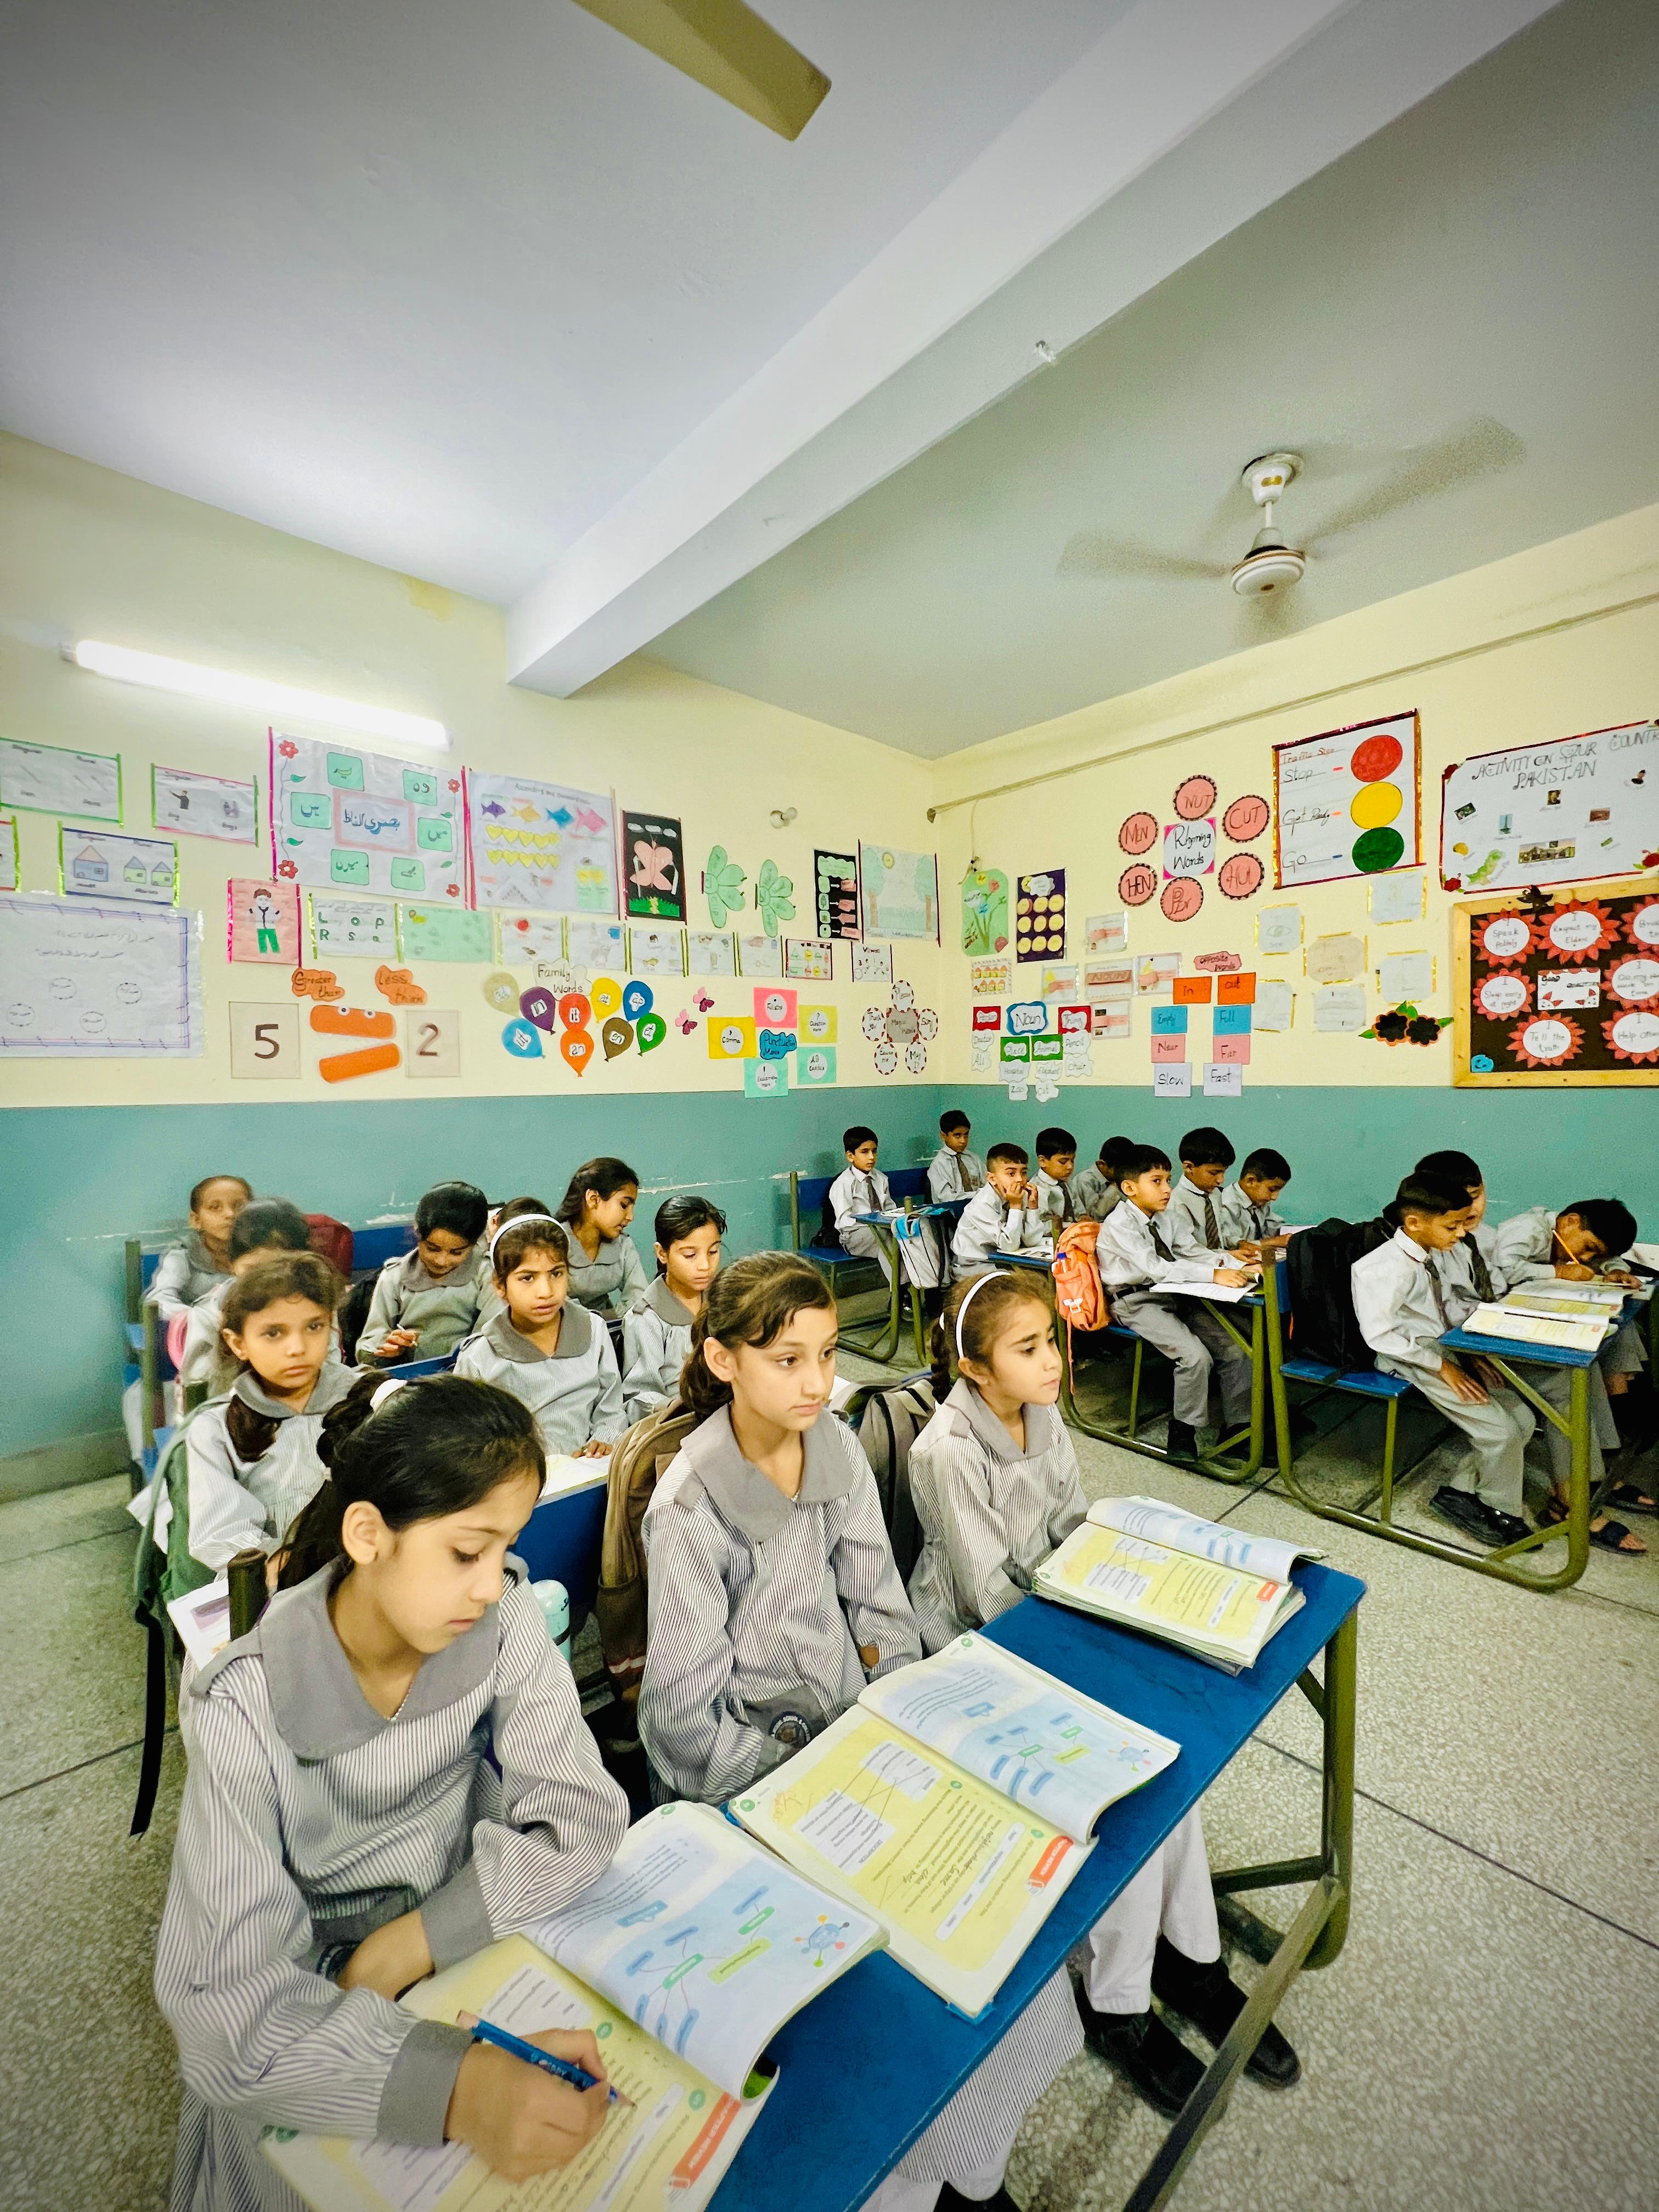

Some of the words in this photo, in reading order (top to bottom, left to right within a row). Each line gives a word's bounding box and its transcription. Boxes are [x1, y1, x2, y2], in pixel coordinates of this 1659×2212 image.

[1284, 765, 1313, 783] Stop
[1513, 759, 1597, 790] PAKISTAN
[1185, 794, 1212, 809] NUT
[1229, 804, 1262, 829] CUT
[1174, 825, 1211, 849] Rhyming
[1174, 852, 1205, 870] Words
[1282, 851, 1307, 874] Go
[538, 964, 570, 981] Family
[554, 980, 583, 994] Words
[1183, 985, 1194, 996] In
[1016, 1013, 1041, 1028] Noun
[255, 1024, 280, 1058] 5
[416, 1023, 439, 1057] 2
[1158, 1041, 1178, 1053] Near
[572, 1045, 584, 1056] an
[1221, 1045, 1237, 1059] Far
[1158, 1073, 1183, 1086] Slow
[1211, 1068, 1231, 1084] Fast
